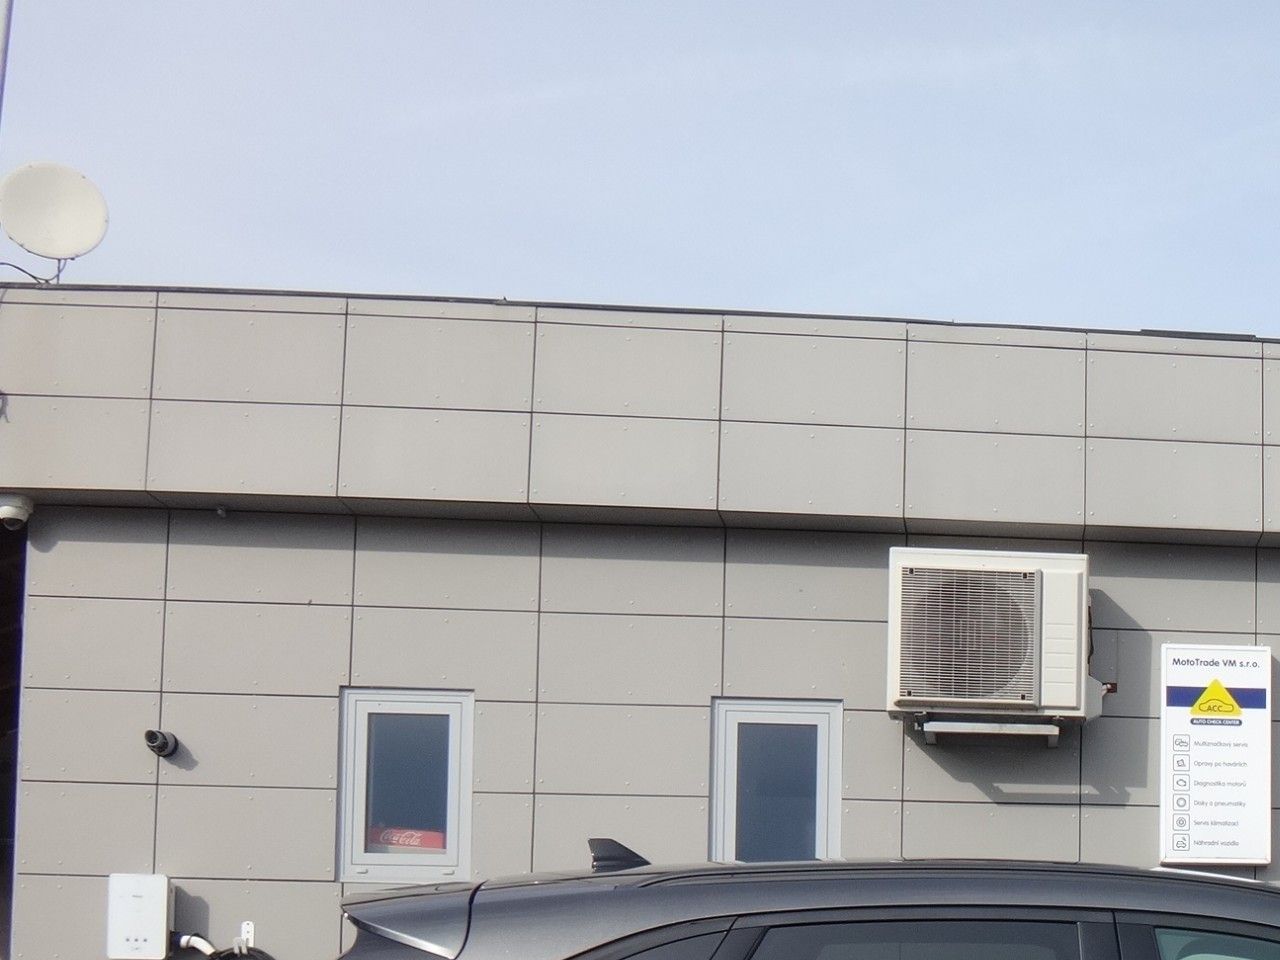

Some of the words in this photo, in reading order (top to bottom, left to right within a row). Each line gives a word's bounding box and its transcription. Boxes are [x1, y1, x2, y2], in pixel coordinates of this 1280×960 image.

[1172, 658, 1220, 668] MotoTrade
[1222, 659, 1237, 668] VM
[1239, 660, 1260, 669] s.r.o.
[1206, 704, 1223, 713] ACC
